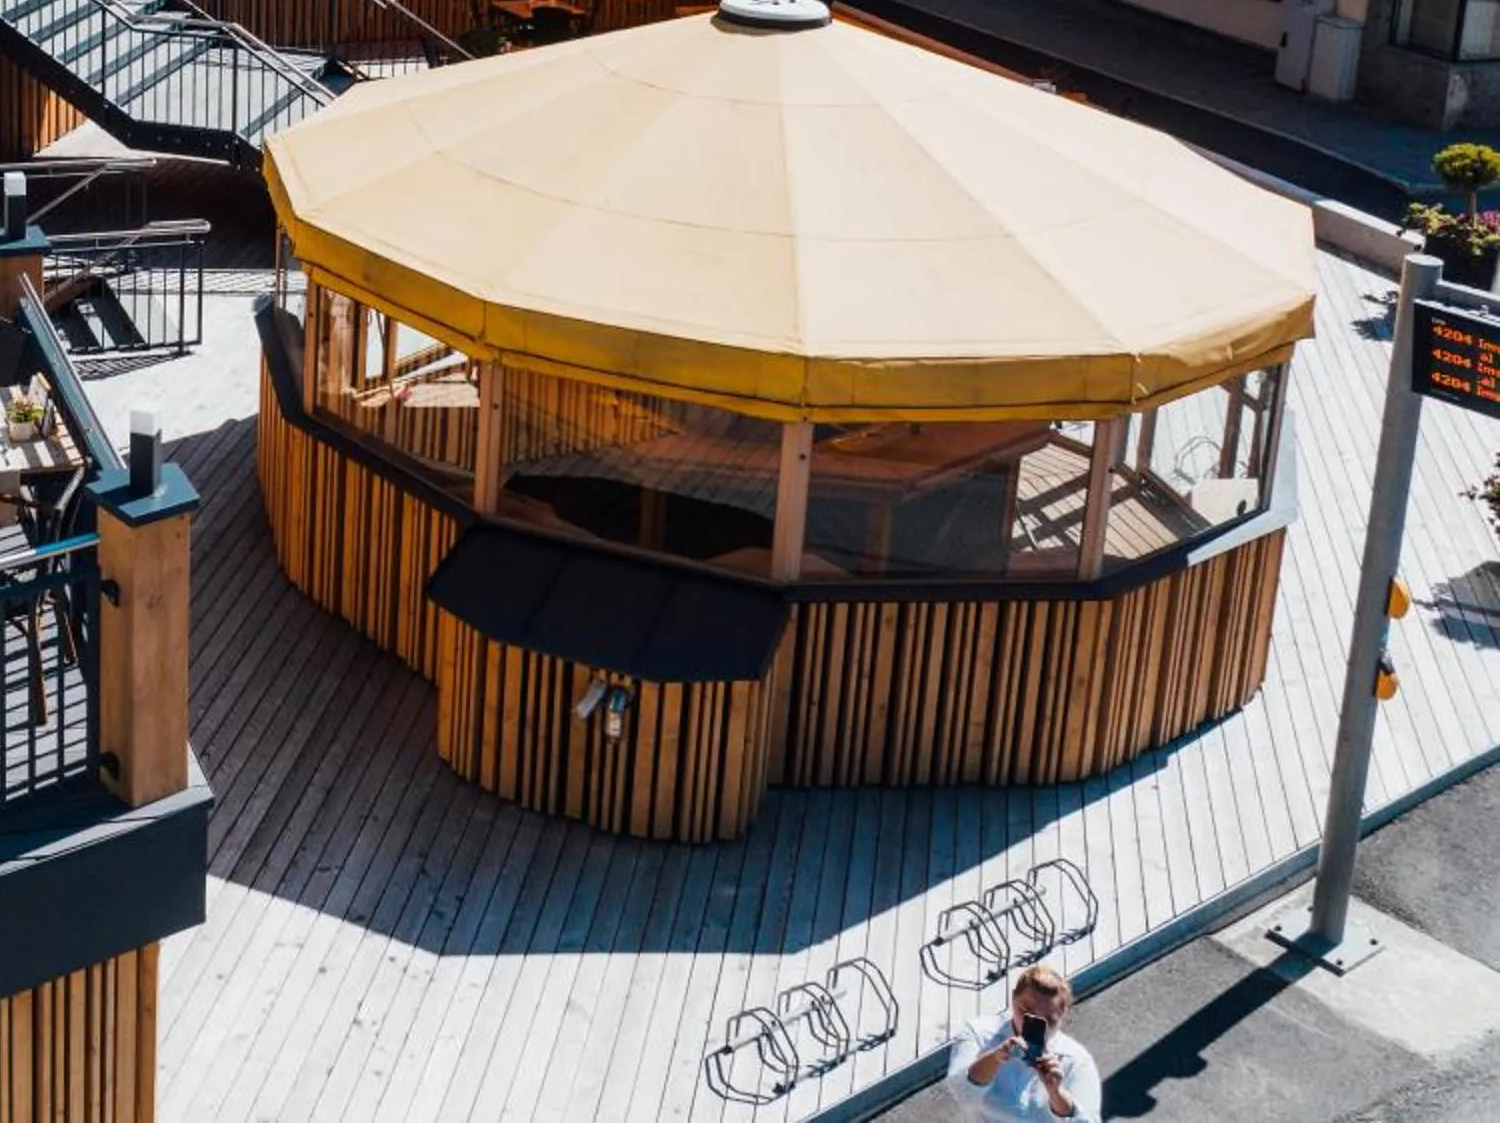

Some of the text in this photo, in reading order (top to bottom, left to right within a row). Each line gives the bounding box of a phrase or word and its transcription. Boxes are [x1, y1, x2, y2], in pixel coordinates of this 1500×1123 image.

[1432, 325, 1473, 345] 4204
[1432, 348, 1471, 368] 4204
[1431, 371, 1471, 392] 4204
